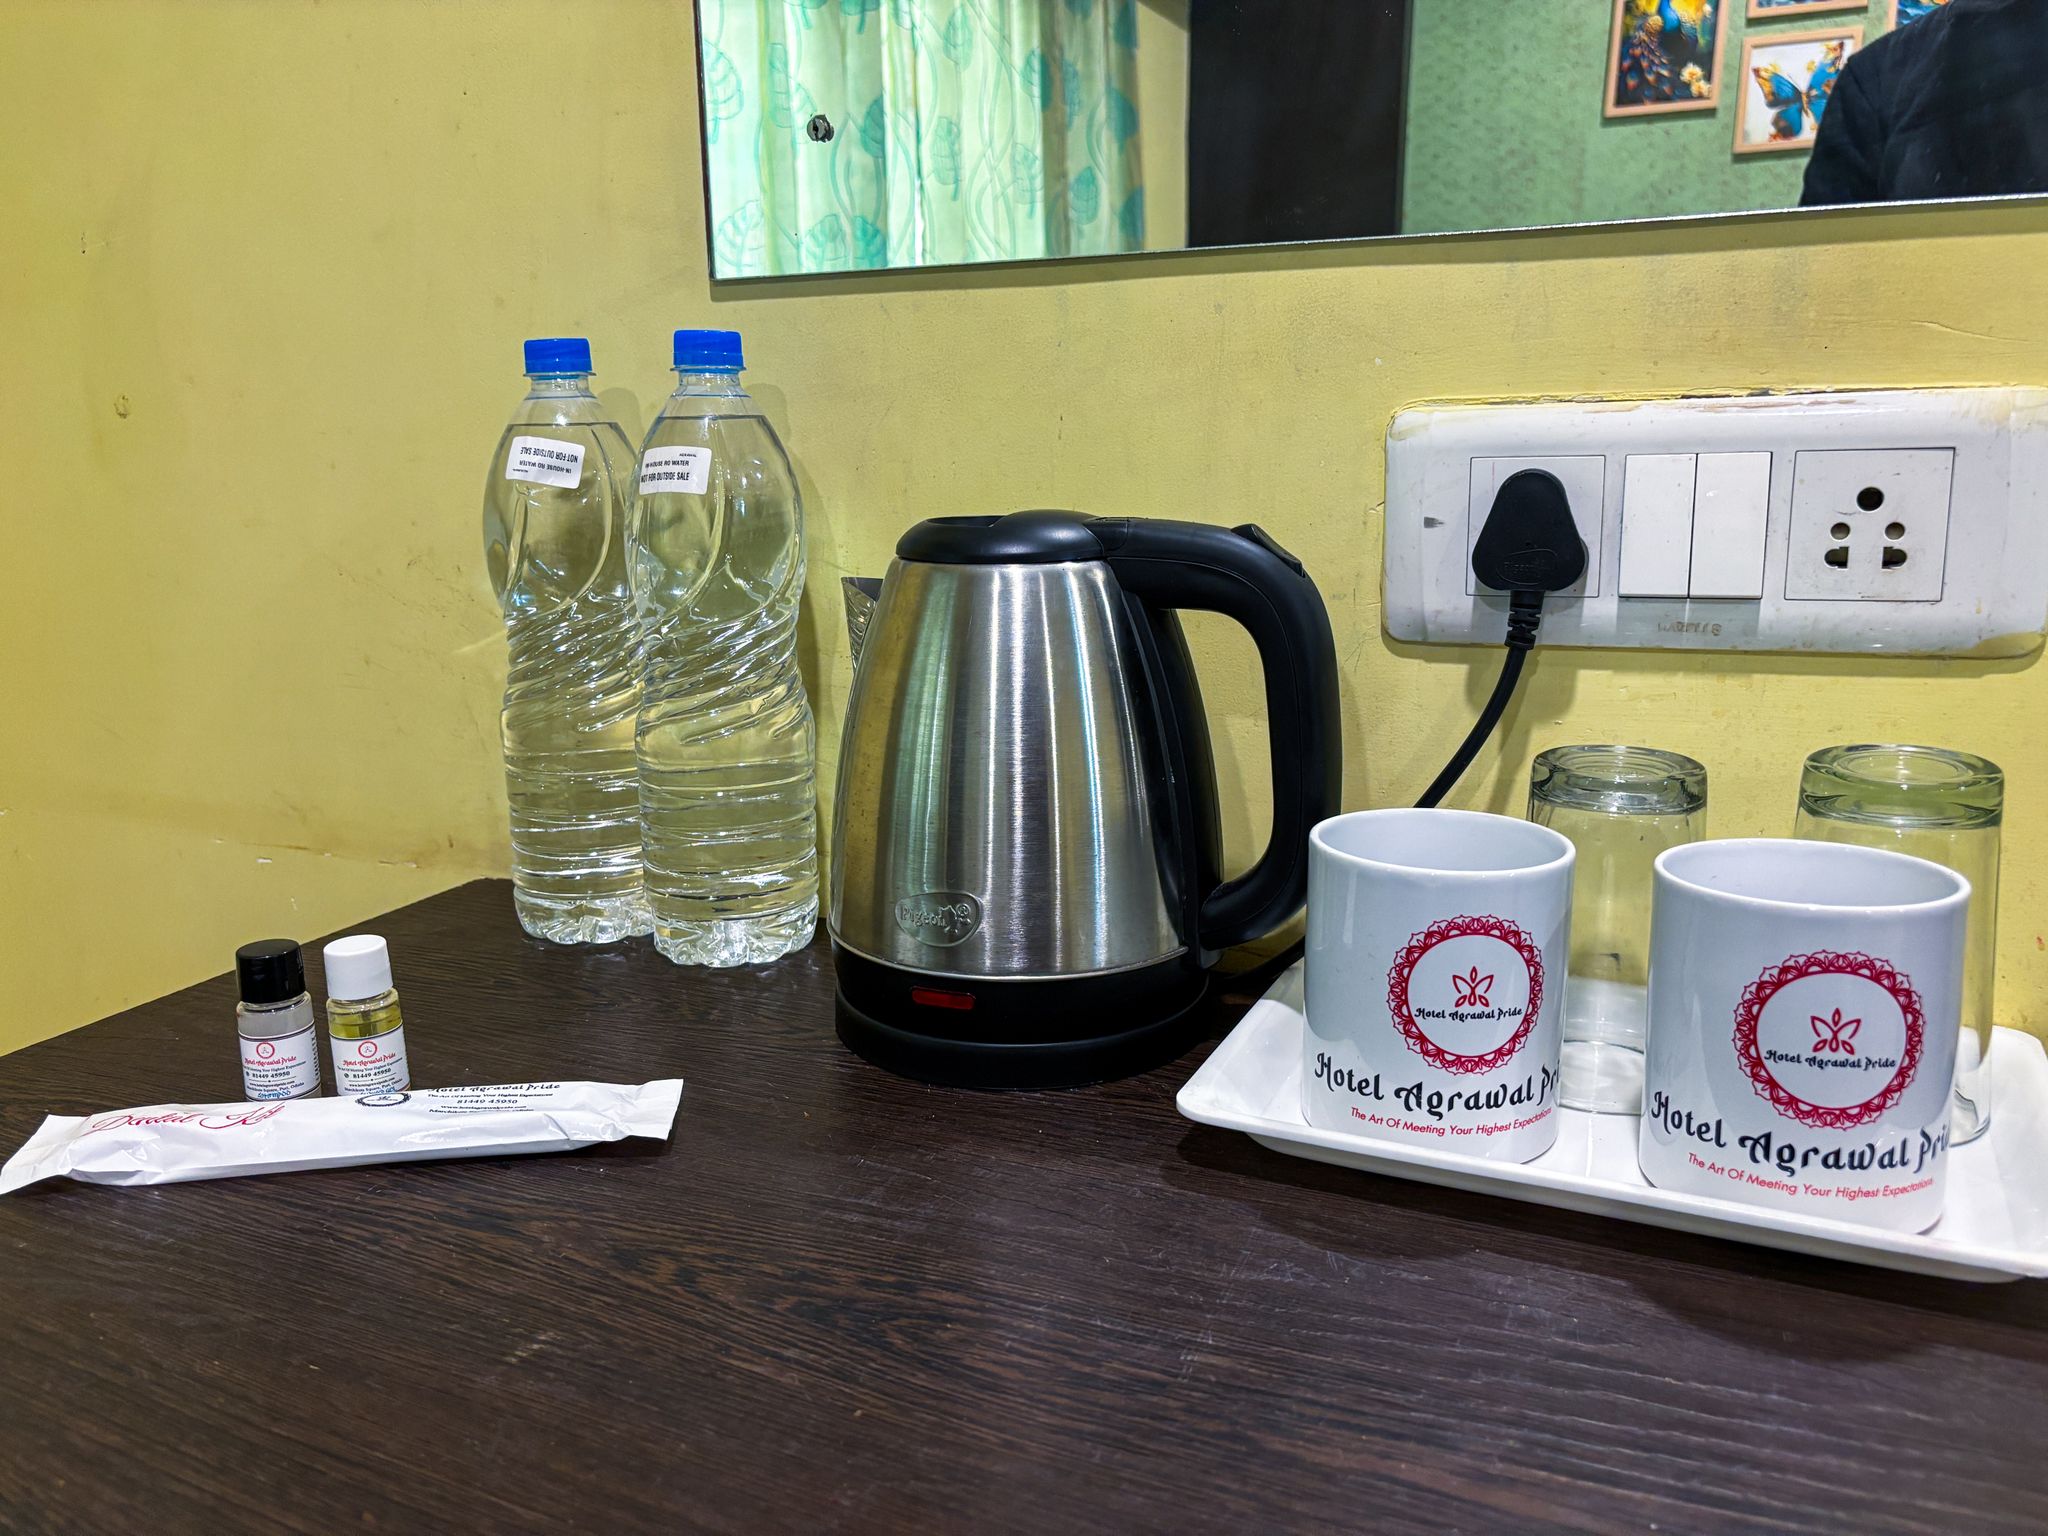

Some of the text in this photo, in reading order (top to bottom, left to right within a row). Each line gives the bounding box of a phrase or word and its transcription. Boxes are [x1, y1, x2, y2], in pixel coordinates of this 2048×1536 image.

[518, 460, 536, 468] WATER
[520, 446, 578, 464] NOT FOR OUTSIDE SALE
[538, 462, 546, 470] RO
[640, 472, 690, 484] NOT FOR OUTSIDE SALE
[900, 904, 947, 927] Pigeon
[1414, 1007, 1523, 1023] Hotel Agrawal Pride
[282, 1056, 297, 1066] Pride
[1764, 1049, 1896, 1071] Hotel Agrawal Pride
[1315, 1051, 1385, 1101] Hotel
[1393, 1073, 1535, 1121] Agrawal
[1350, 1106, 1553, 1138] The Art Of Meeting Your Highest Expectations
[1650, 1090, 1728, 1149] Hotel
[1737, 1129, 1911, 1178] Agrawal
[1687, 1151, 1934, 1202] The Art Of Meeting Your Highest Expectations
